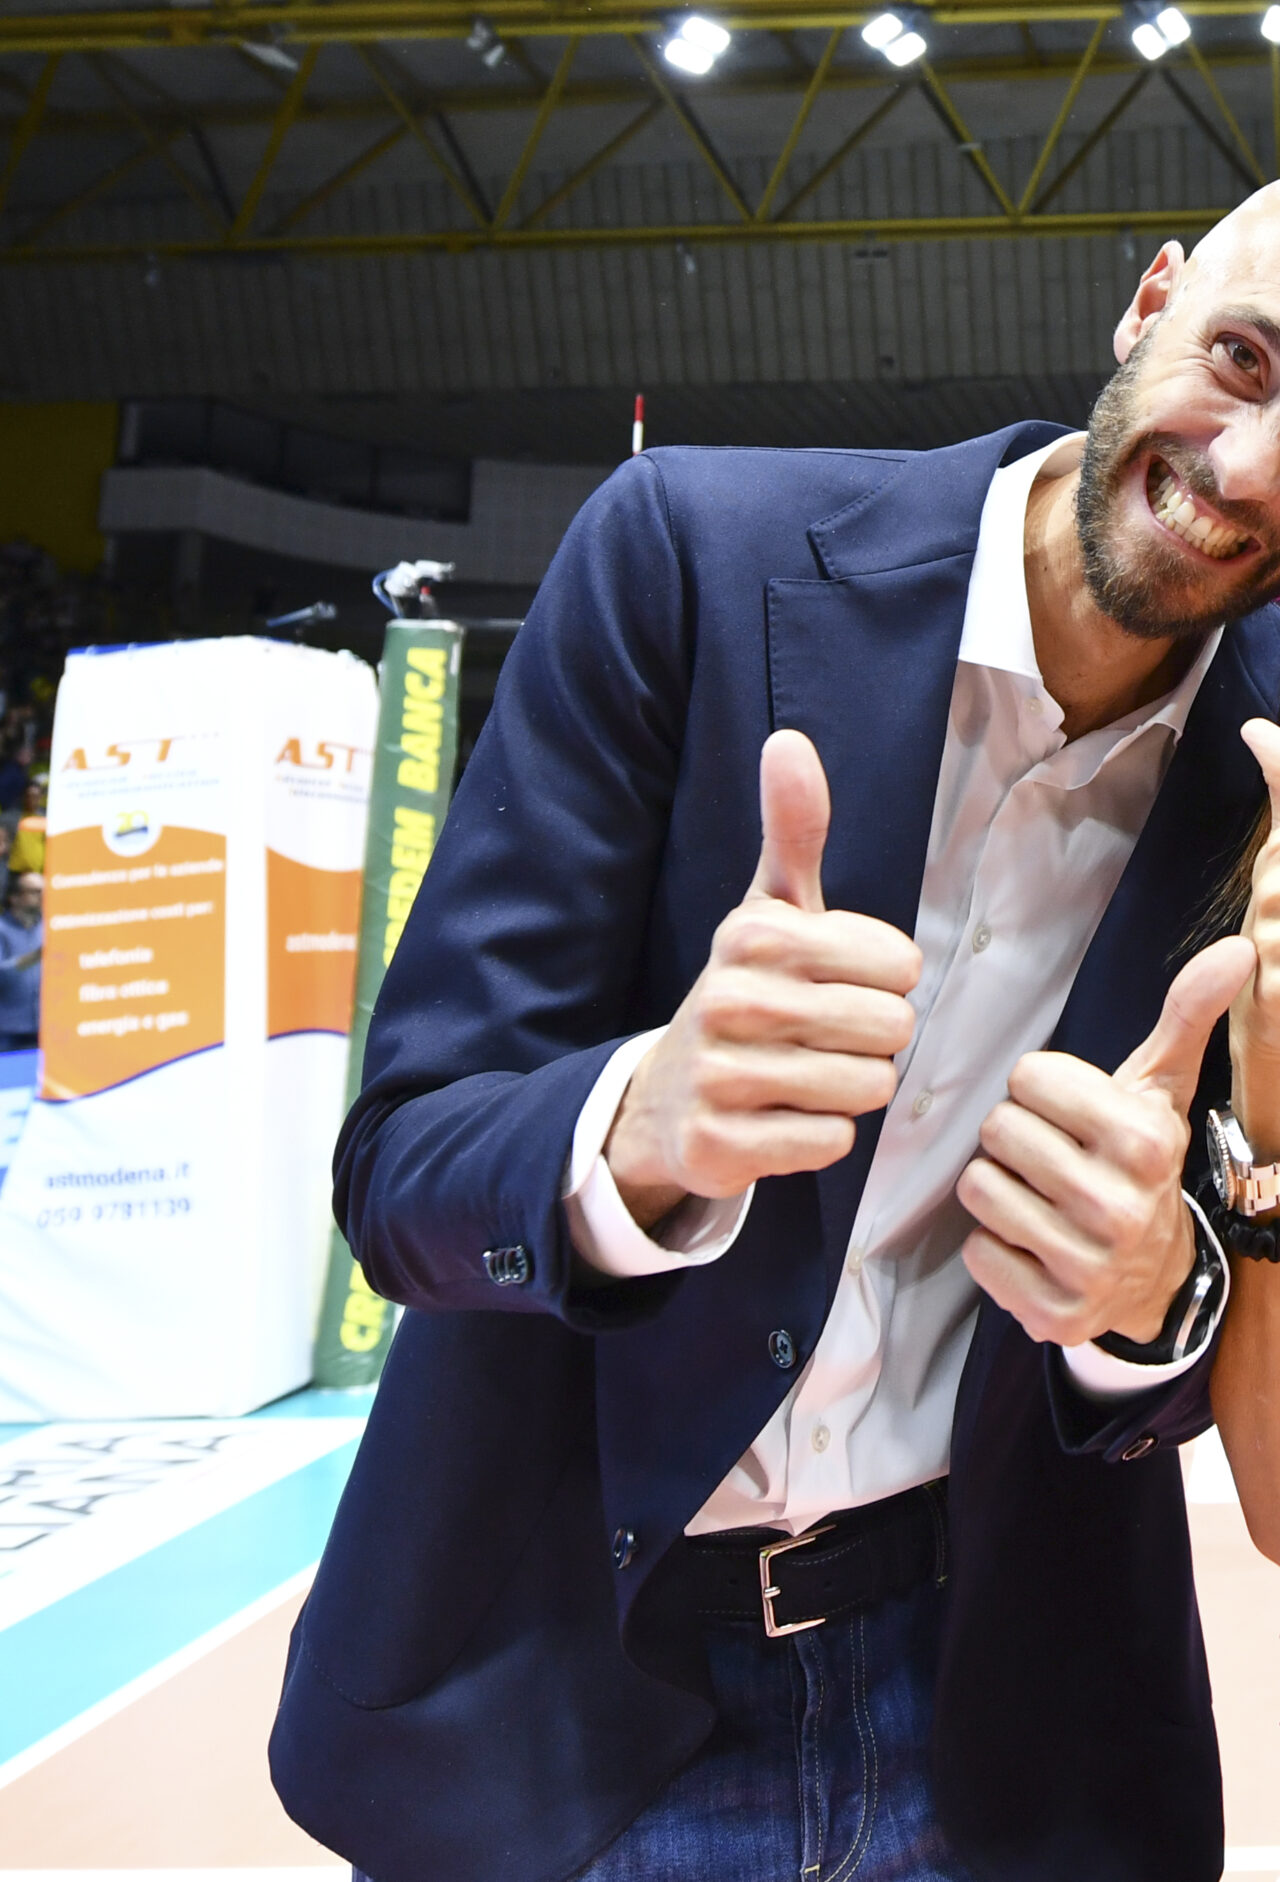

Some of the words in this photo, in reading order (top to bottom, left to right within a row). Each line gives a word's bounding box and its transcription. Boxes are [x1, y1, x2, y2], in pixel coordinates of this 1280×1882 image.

[398, 647, 447, 793] BANCA
[61, 738, 173, 773] AST
[275, 737, 357, 774] AST
[79, 947, 153, 970] telefonia
